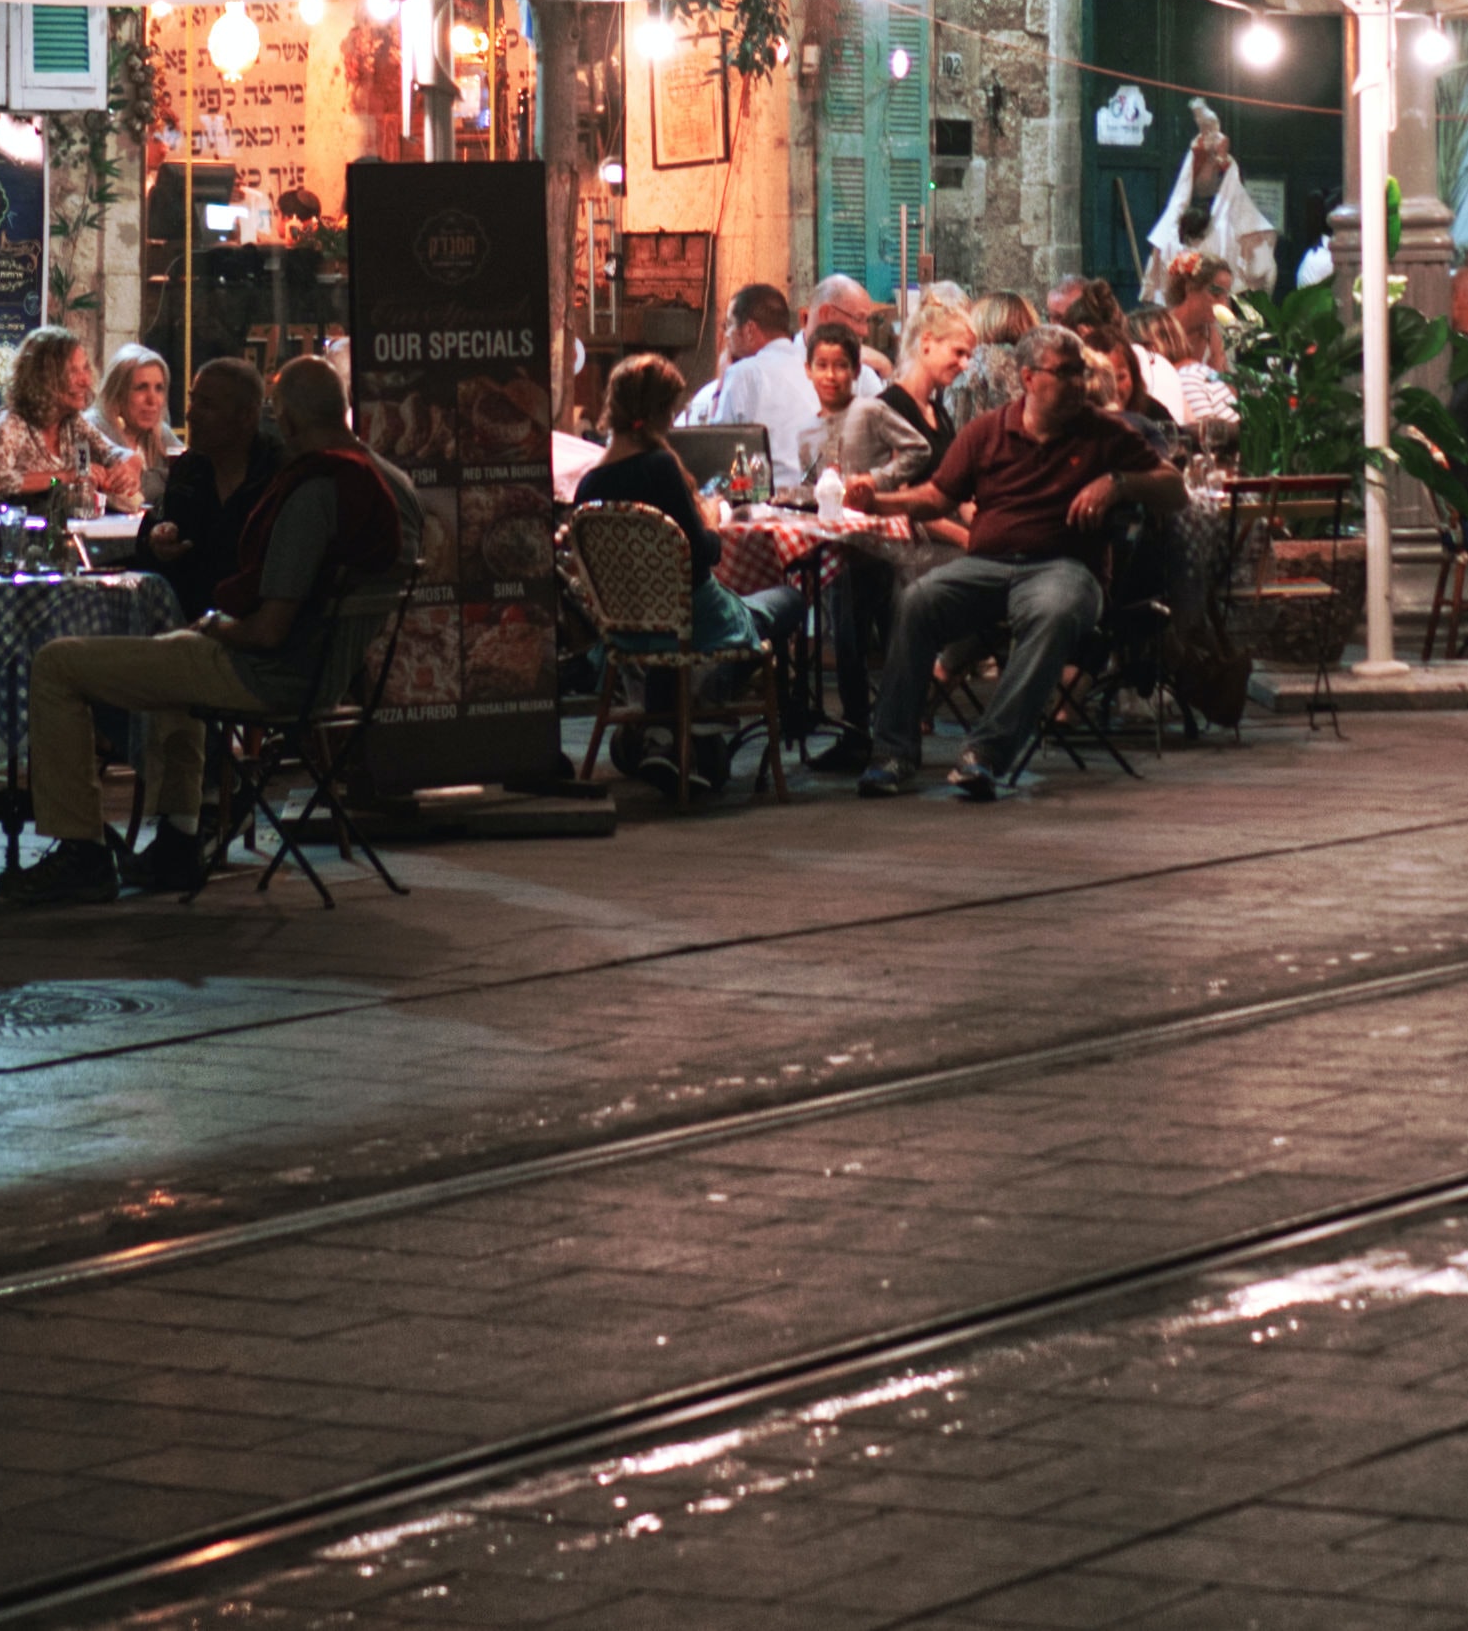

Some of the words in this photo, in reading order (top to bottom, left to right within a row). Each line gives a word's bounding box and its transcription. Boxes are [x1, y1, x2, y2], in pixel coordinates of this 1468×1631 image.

[942, 55, 961, 75] 102
[374, 332, 422, 363] OUR
[428, 329, 533, 361] SPECIALS
[411, 467, 438, 485] FISH
[462, 466, 482, 482] RED
[483, 465, 509, 480] TUNA
[510, 464, 549, 479] BURGER
[493, 581, 525, 600] SINIA
[405, 704, 458, 723] ALFREDO
[466, 701, 518, 717] JERUSALEM
